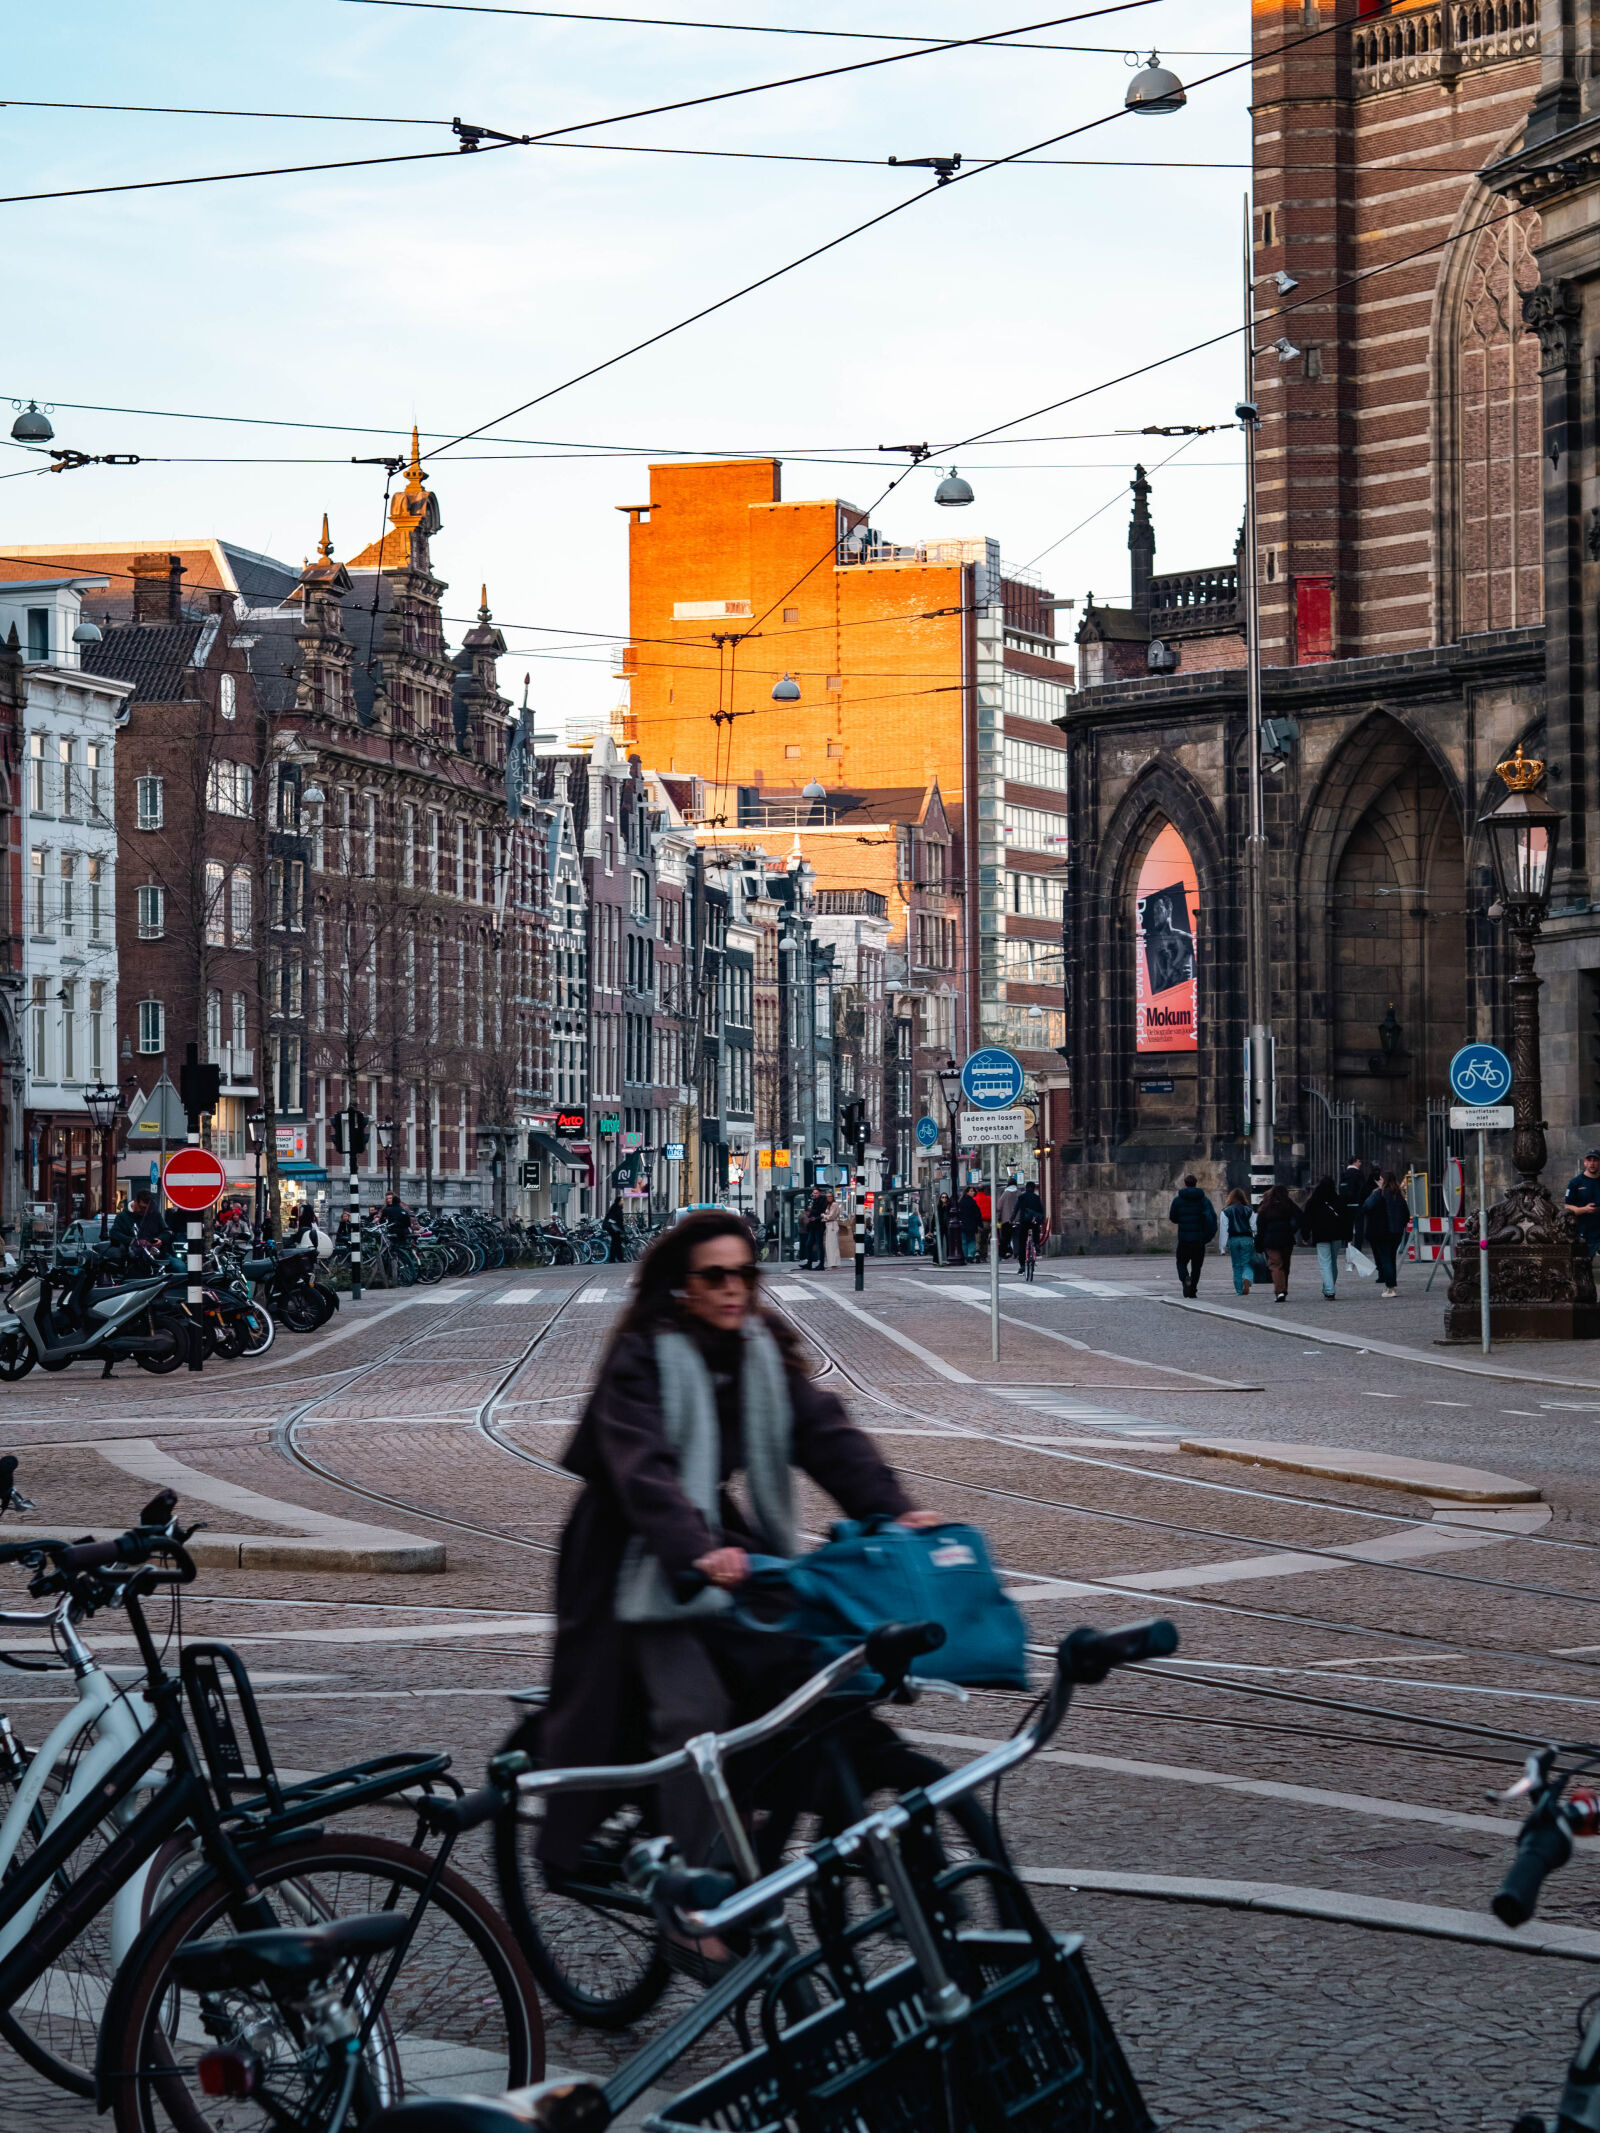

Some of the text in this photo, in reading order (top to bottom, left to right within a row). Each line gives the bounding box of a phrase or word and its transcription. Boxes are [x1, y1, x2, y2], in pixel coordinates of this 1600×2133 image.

[1136, 1002, 1147, 1045] Kerk
[1146, 1006, 1191, 1027] Mokum
[557, 1113, 584, 1126] Arto
[972, 1125, 1014, 1133] toegestaan
